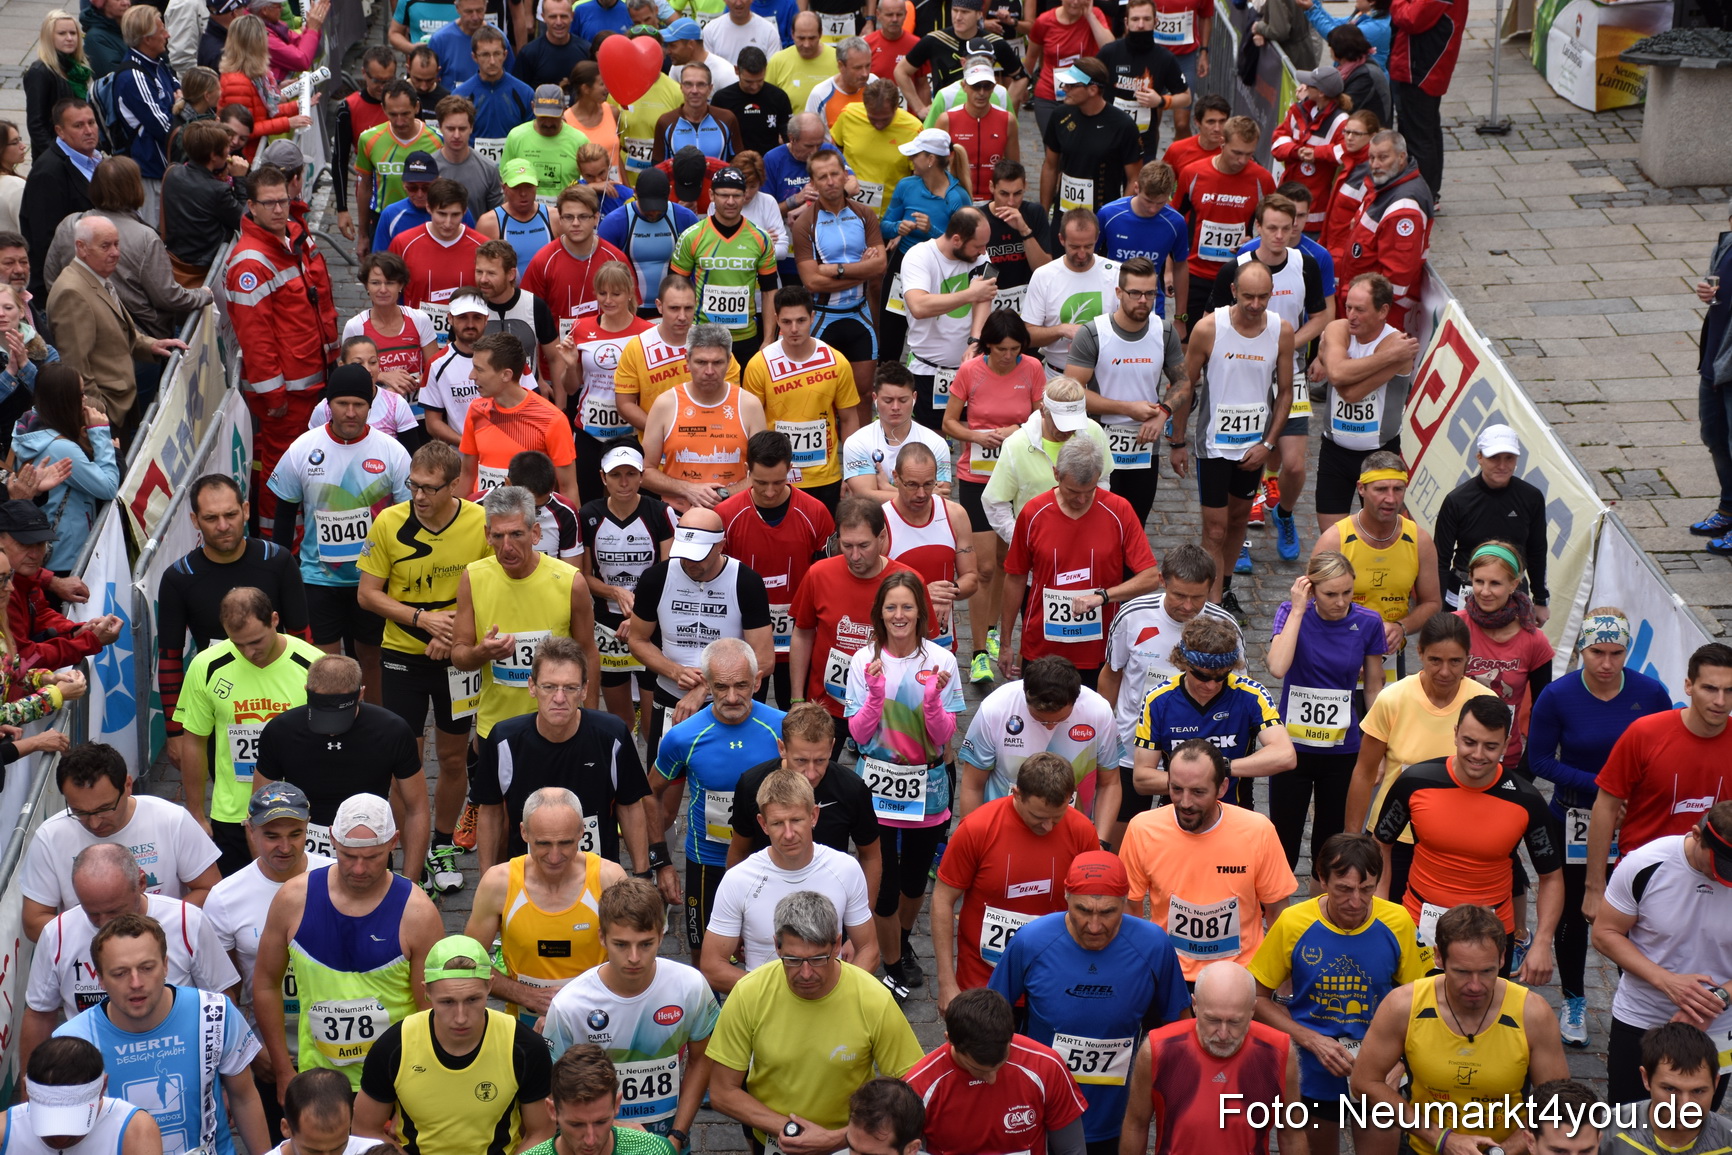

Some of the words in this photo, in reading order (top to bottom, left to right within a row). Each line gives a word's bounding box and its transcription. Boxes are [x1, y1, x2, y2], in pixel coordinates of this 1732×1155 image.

[830, 21, 845, 35] 47
[1155, 21, 1182, 34] 2231
[1117, 75, 1143, 87] TOUGH
[1064, 185, 1085, 203] 504
[1204, 231, 1241, 247] 2197
[1116, 248, 1159, 260] SYSCAD
[699, 256, 758, 271] BOCK
[707, 296, 746, 313] 2809
[713, 315, 738, 324] Thomas
[1236, 353, 1266, 362] KLEBL
[649, 366, 681, 385] MAX
[773, 378, 803, 395] MAX
[806, 370, 839, 386] BÖGL
[1336, 401, 1375, 420] 2058
[793, 424, 819, 432] Neumarkt
[1220, 414, 1260, 433] 2411
[1341, 423, 1365, 433] Roland
[599, 428, 618, 437] Steffi
[1116, 455, 1138, 464] Daniel
[332, 513, 361, 522] Neumarkt
[320, 520, 368, 543] 3040
[598, 551, 653, 562] POSITIV
[1065, 572, 1082, 581] DEHN
[671, 600, 728, 615] POSITIV
[676, 624, 721, 637] WOLFRUM
[1062, 626, 1083, 636] Ernst
[602, 657, 629, 667] Angela
[1290, 691, 1311, 700] PARTL
[1311, 694, 1341, 702] Neumarkt
[233, 698, 291, 713] Müller
[1300, 701, 1339, 726] 362
[1071, 728, 1093, 739] Hervis
[1170, 726, 1199, 734] TEAM
[1305, 729, 1330, 740] Nadja
[1004, 737, 1024, 745] PARTL
[866, 762, 886, 773] PARTL
[869, 773, 921, 799] 2293
[707, 793, 730, 803] PARTL
[878, 800, 905, 812] Gisela
[1216, 865, 1247, 874] THULE
[1019, 884, 1039, 894] DEHN
[1170, 901, 1193, 915] PARTL
[1193, 905, 1227, 917] Neumarkt
[986, 912, 1009, 926] PARTL
[1175, 911, 1234, 939] 2087
[1188, 942, 1219, 953] Marco
[1074, 984, 1114, 994] ERTEL
[334, 1003, 374, 1014] Neumarkt
[657, 1009, 682, 1021] Hervis
[323, 1015, 375, 1041] 378
[587, 1032, 612, 1042] PARTL
[1056, 1035, 1083, 1047] PARTL
[1084, 1040, 1121, 1049] Neumarkt
[114, 1035, 185, 1055] VIERTL
[205, 1025, 215, 1075] VIERTL
[116, 1052, 157, 1066] DESIGN
[157, 1046, 187, 1060] GmbH
[338, 1045, 363, 1058] Andi
[1067, 1048, 1118, 1073] 537
[626, 1065, 666, 1075] Neumarkt
[622, 1071, 673, 1101] 648
[621, 1104, 656, 1117] Niklas
[1008, 1104, 1030, 1112] Laufteam
